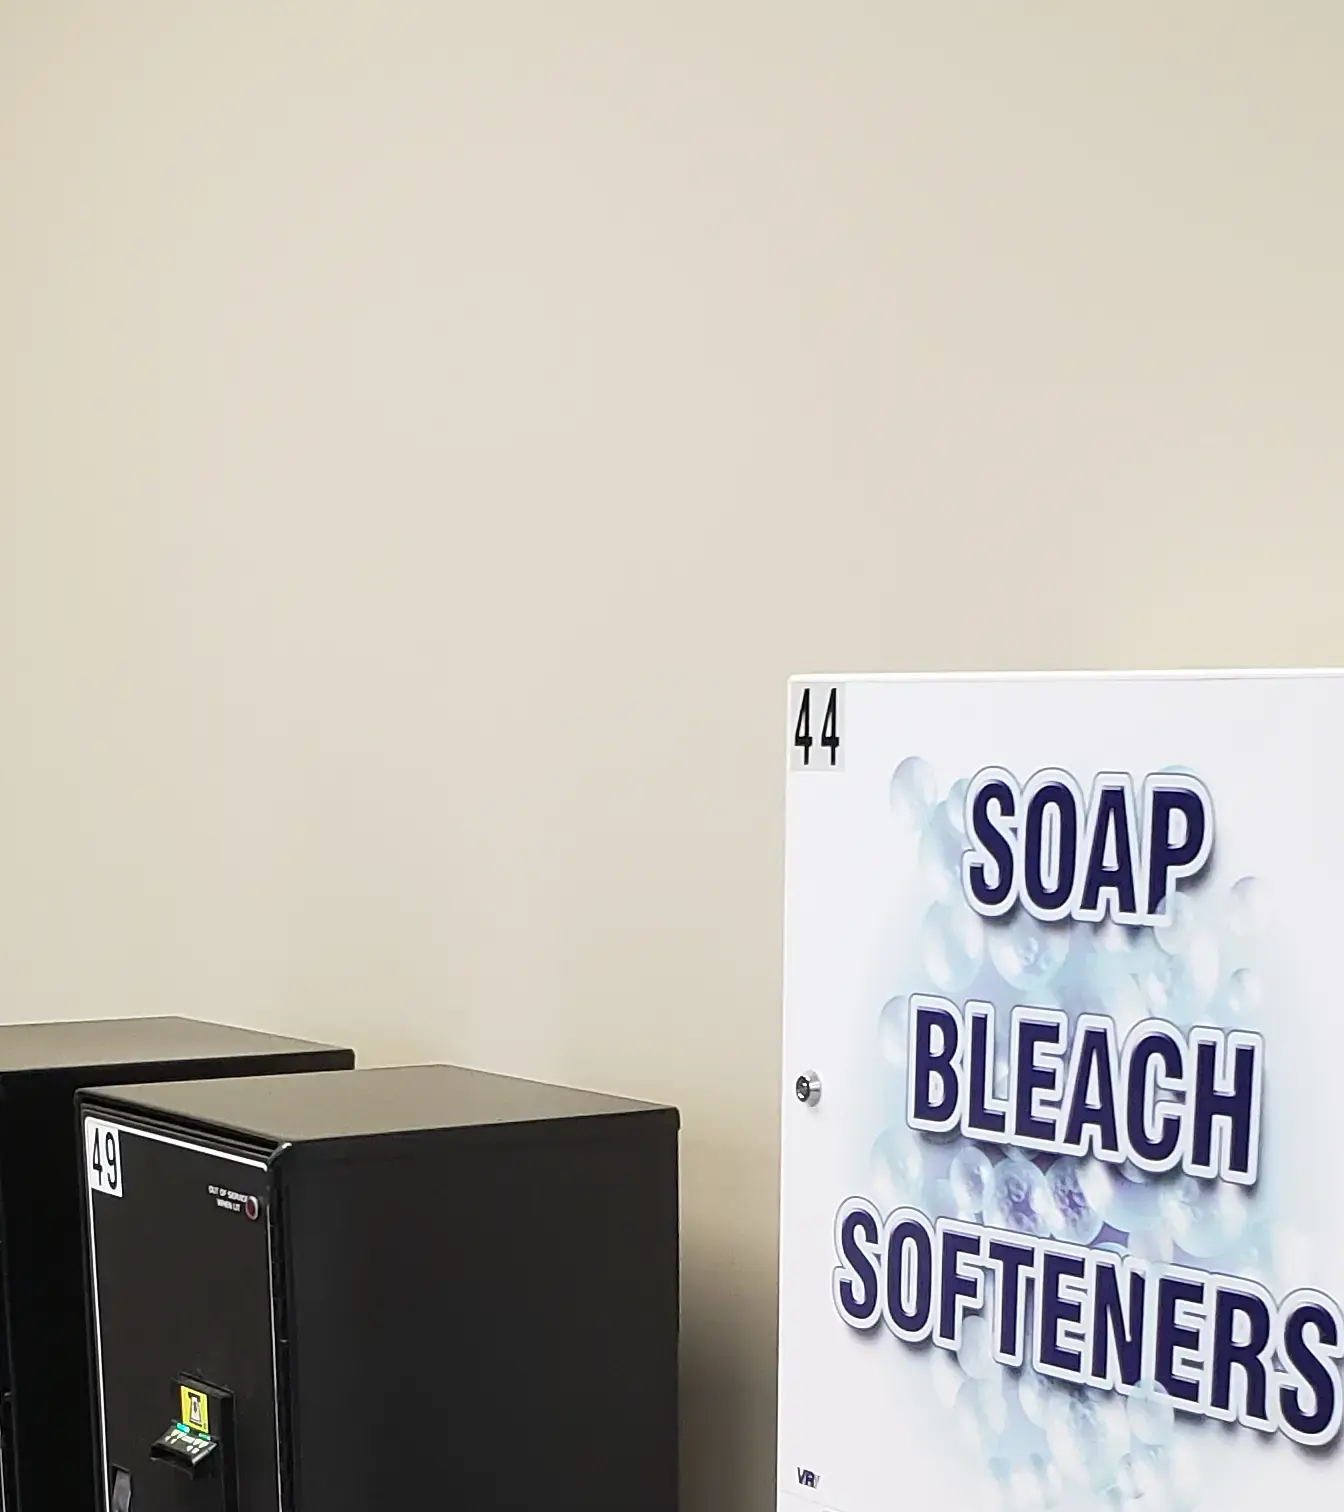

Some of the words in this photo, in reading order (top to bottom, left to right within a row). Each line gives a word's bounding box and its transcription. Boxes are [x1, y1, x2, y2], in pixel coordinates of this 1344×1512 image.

[794, 688, 840, 766] 44
[967, 775, 1209, 919] SOAP
[92, 1128, 117, 1190] 49
[911, 1003, 1258, 1177] BLEACH
[836, 1204, 1342, 1438] SOFTENERS
